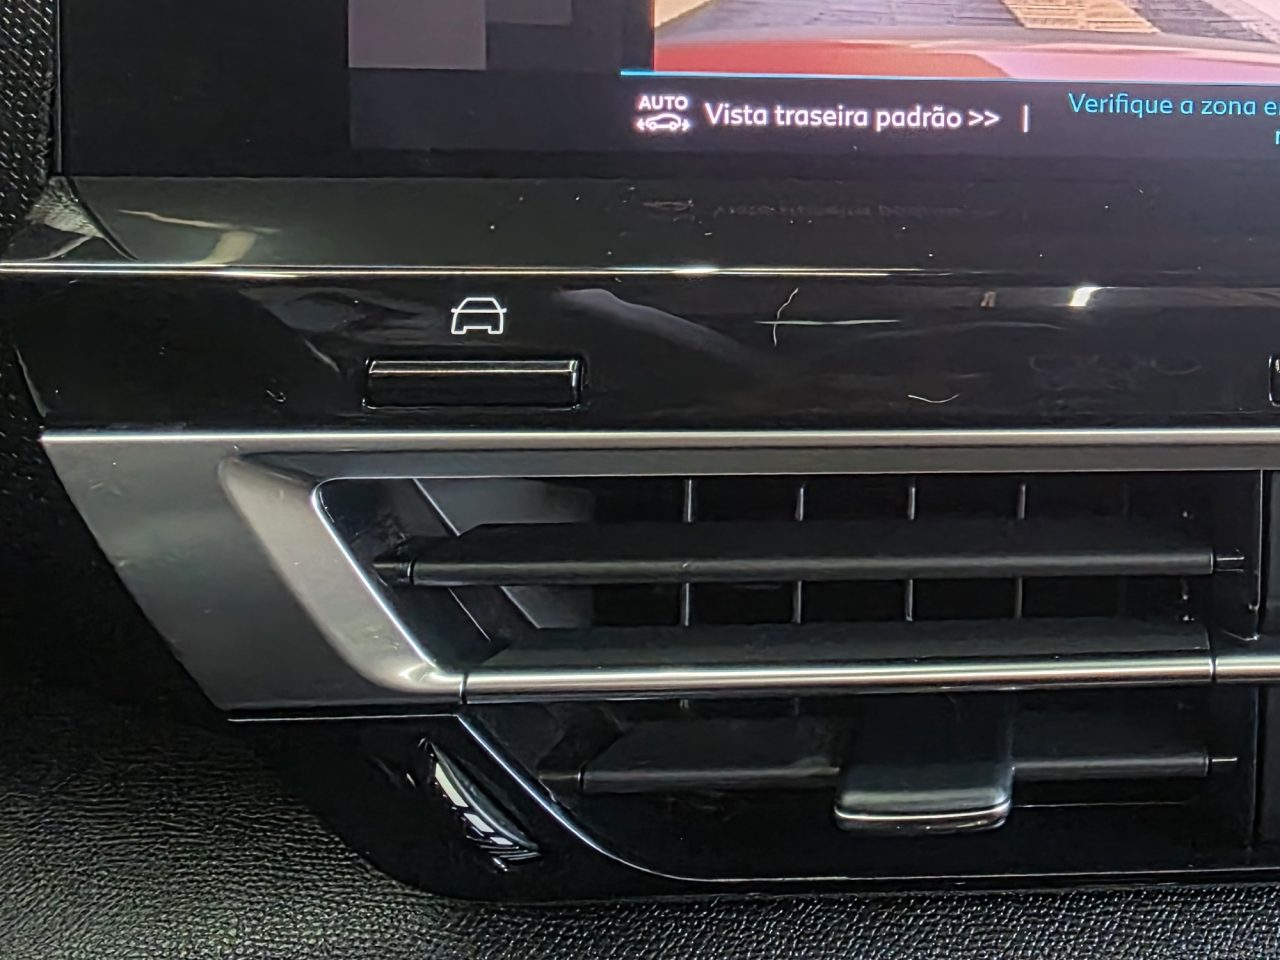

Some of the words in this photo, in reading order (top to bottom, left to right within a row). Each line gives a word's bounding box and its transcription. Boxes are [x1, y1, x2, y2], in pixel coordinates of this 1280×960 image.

[638, 95, 689, 111] AUTO
[1068, 92, 1173, 119] Verifique
[1180, 99, 1194, 115] a
[1201, 99, 1256, 117] zona
[705, 103, 768, 127] Vista
[774, 105, 868, 128] traseira
[876, 106, 962, 132] padrão
